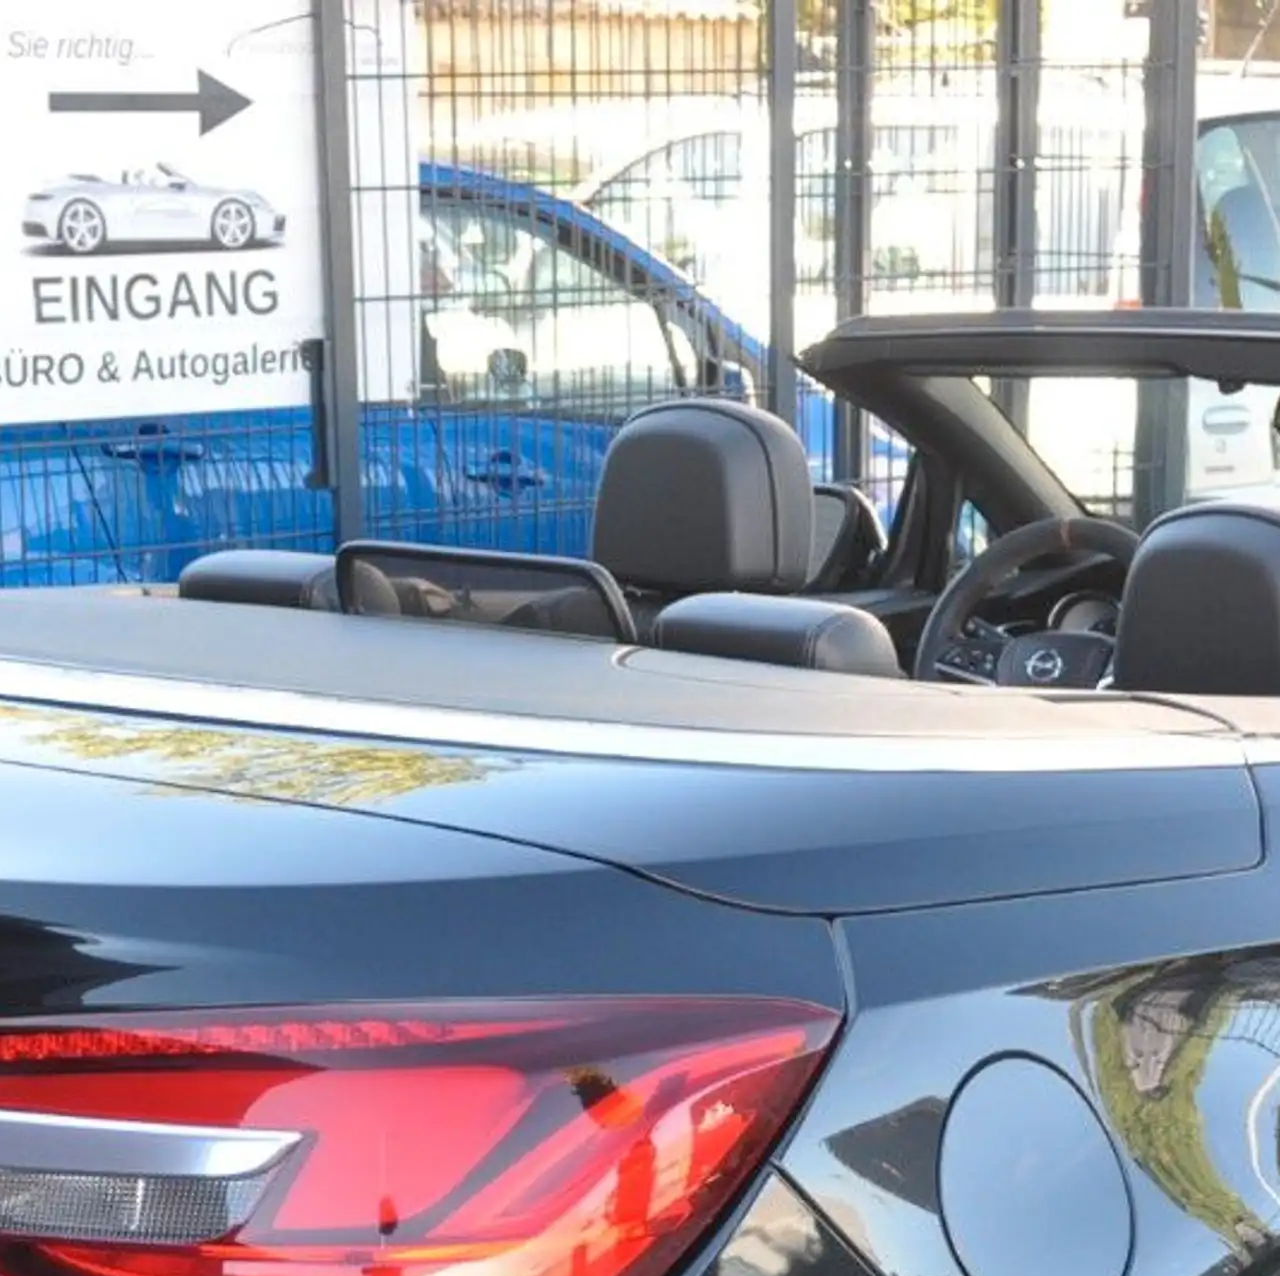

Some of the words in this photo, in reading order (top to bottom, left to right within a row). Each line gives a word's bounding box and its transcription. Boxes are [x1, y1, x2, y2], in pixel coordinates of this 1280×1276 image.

[8, 31, 50, 59] Sie
[32, 269, 280, 325] EINGANG
[96, 352, 121, 383] &
